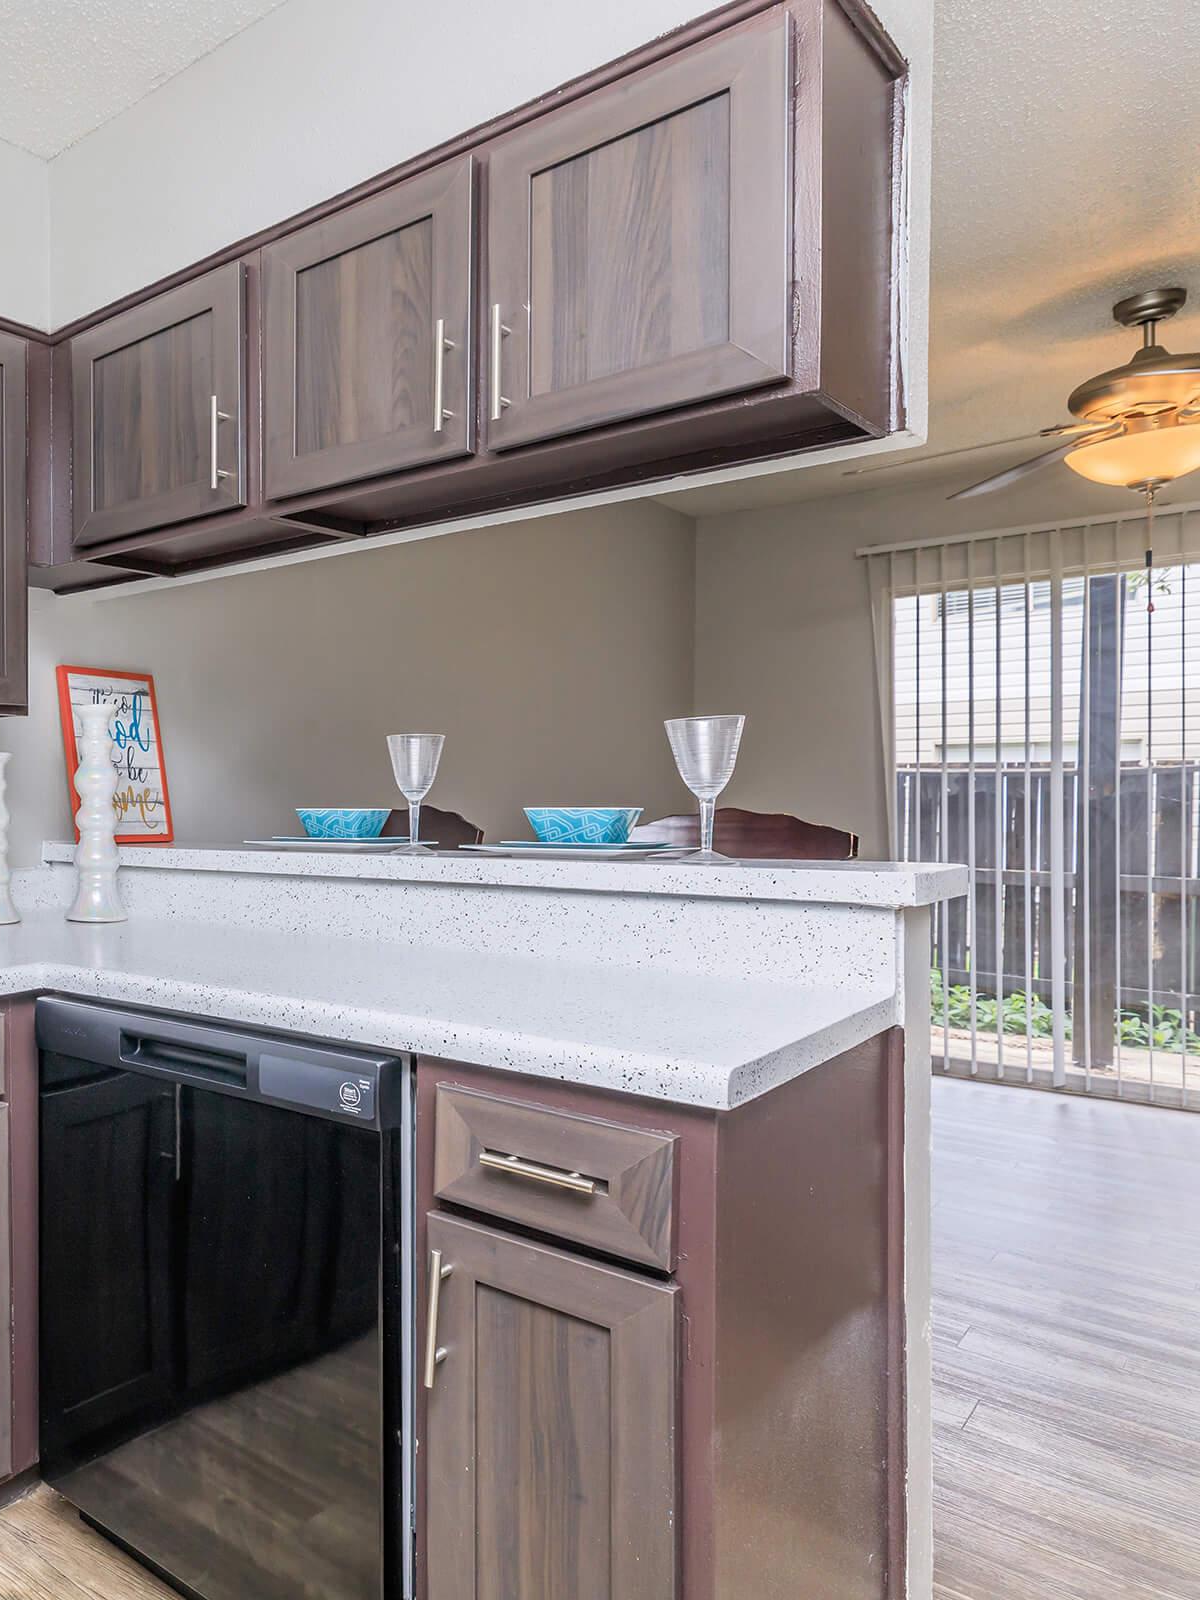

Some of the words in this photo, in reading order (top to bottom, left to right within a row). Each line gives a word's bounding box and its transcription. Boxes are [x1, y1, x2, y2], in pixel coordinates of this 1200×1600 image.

[108, 694, 150, 752] od
[127, 746, 148, 783] be
[112, 785, 159, 829] ome
